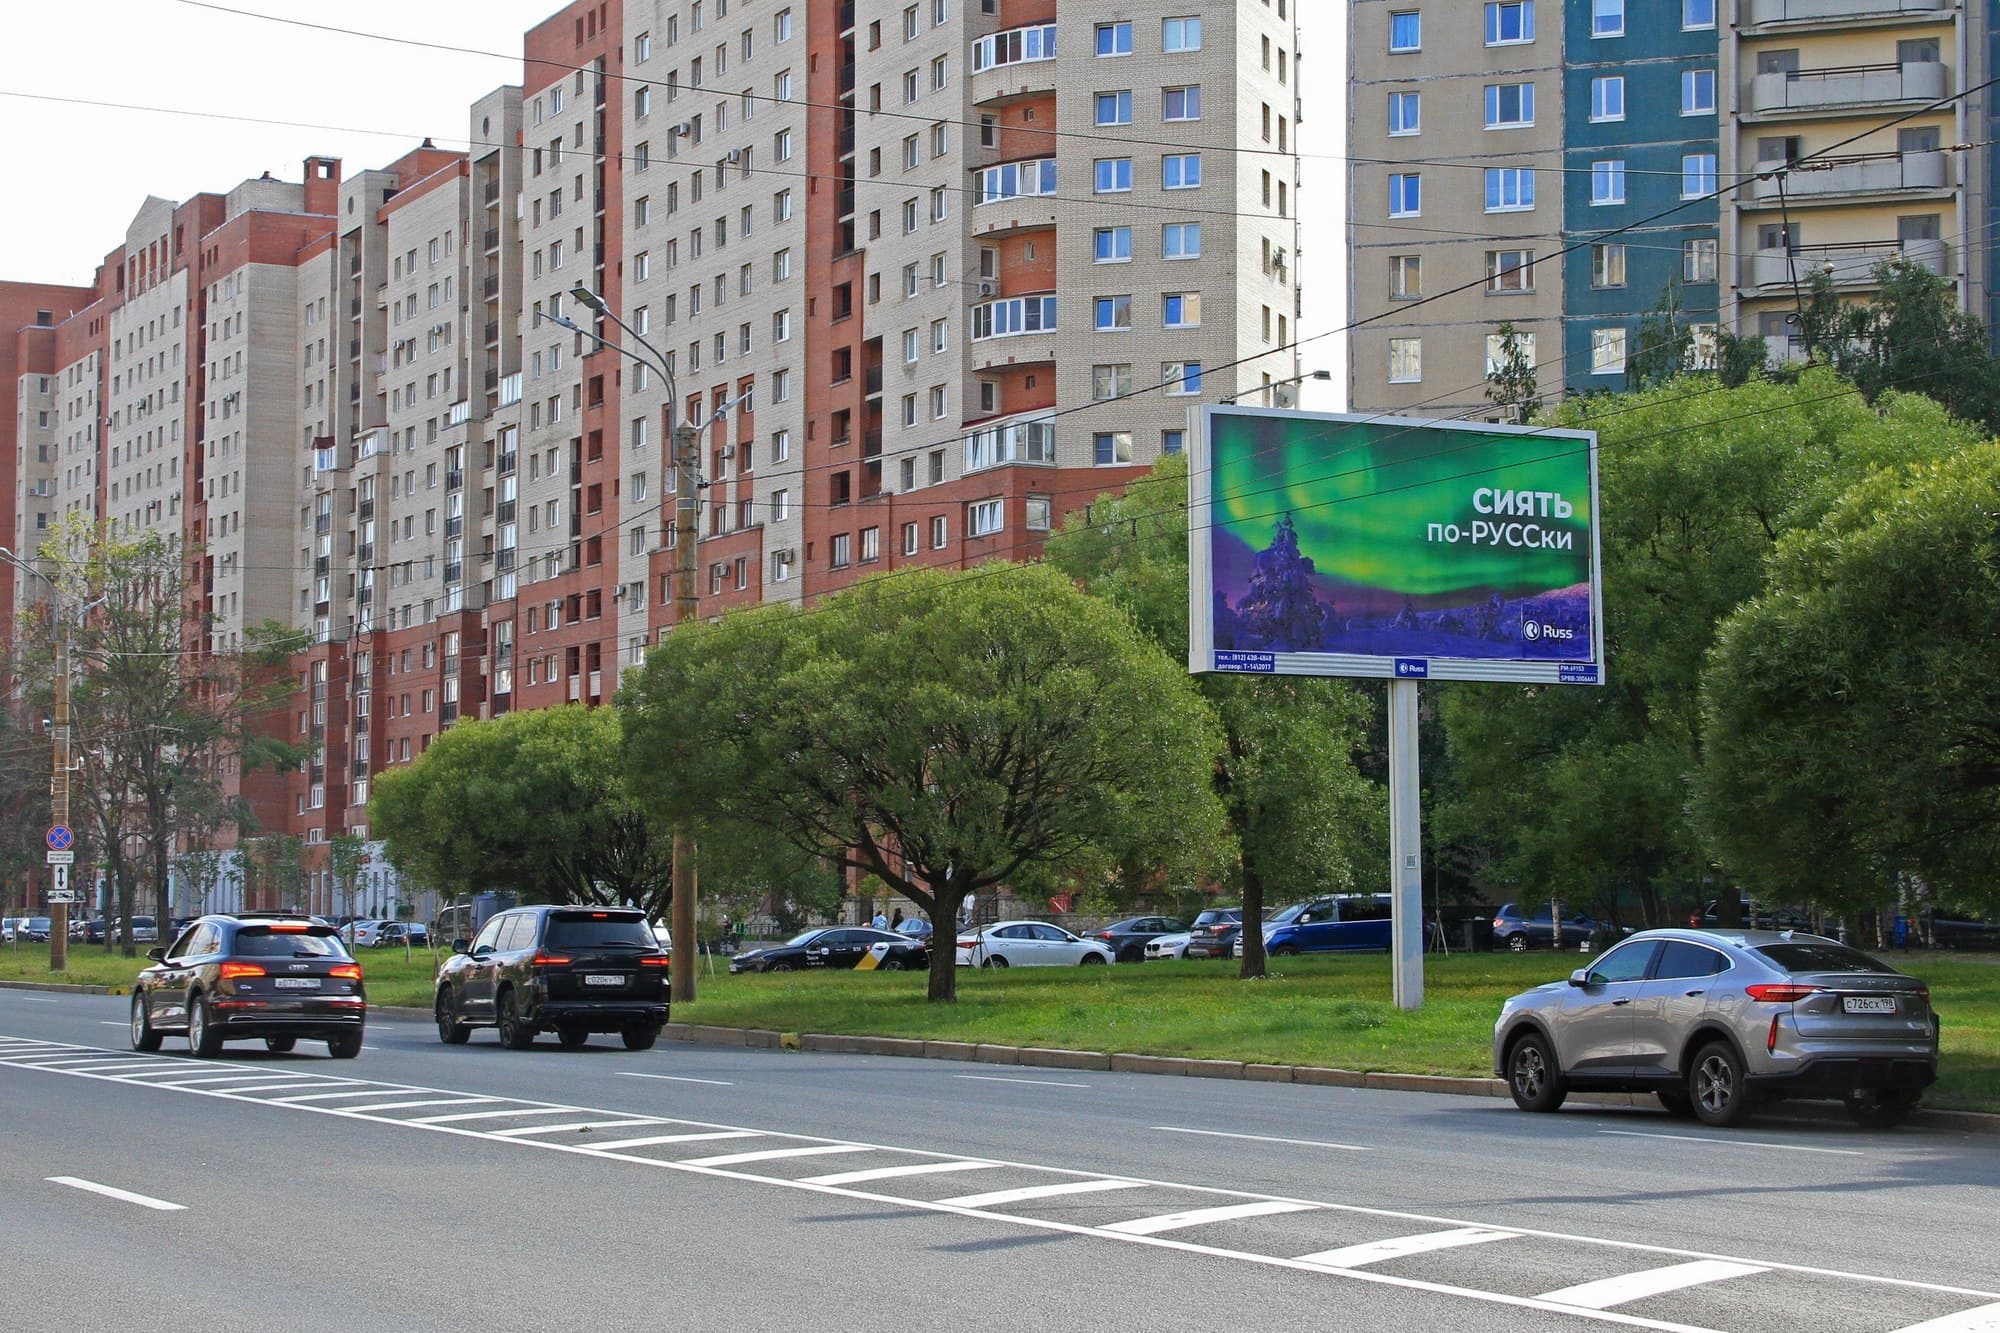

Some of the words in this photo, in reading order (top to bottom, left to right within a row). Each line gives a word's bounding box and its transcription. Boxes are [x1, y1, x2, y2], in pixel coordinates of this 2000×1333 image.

[1472, 487, 1573, 519] СИЯТЬ
[1543, 624, 1573, 639] Russ
[1409, 664, 1425, 672] Russ
